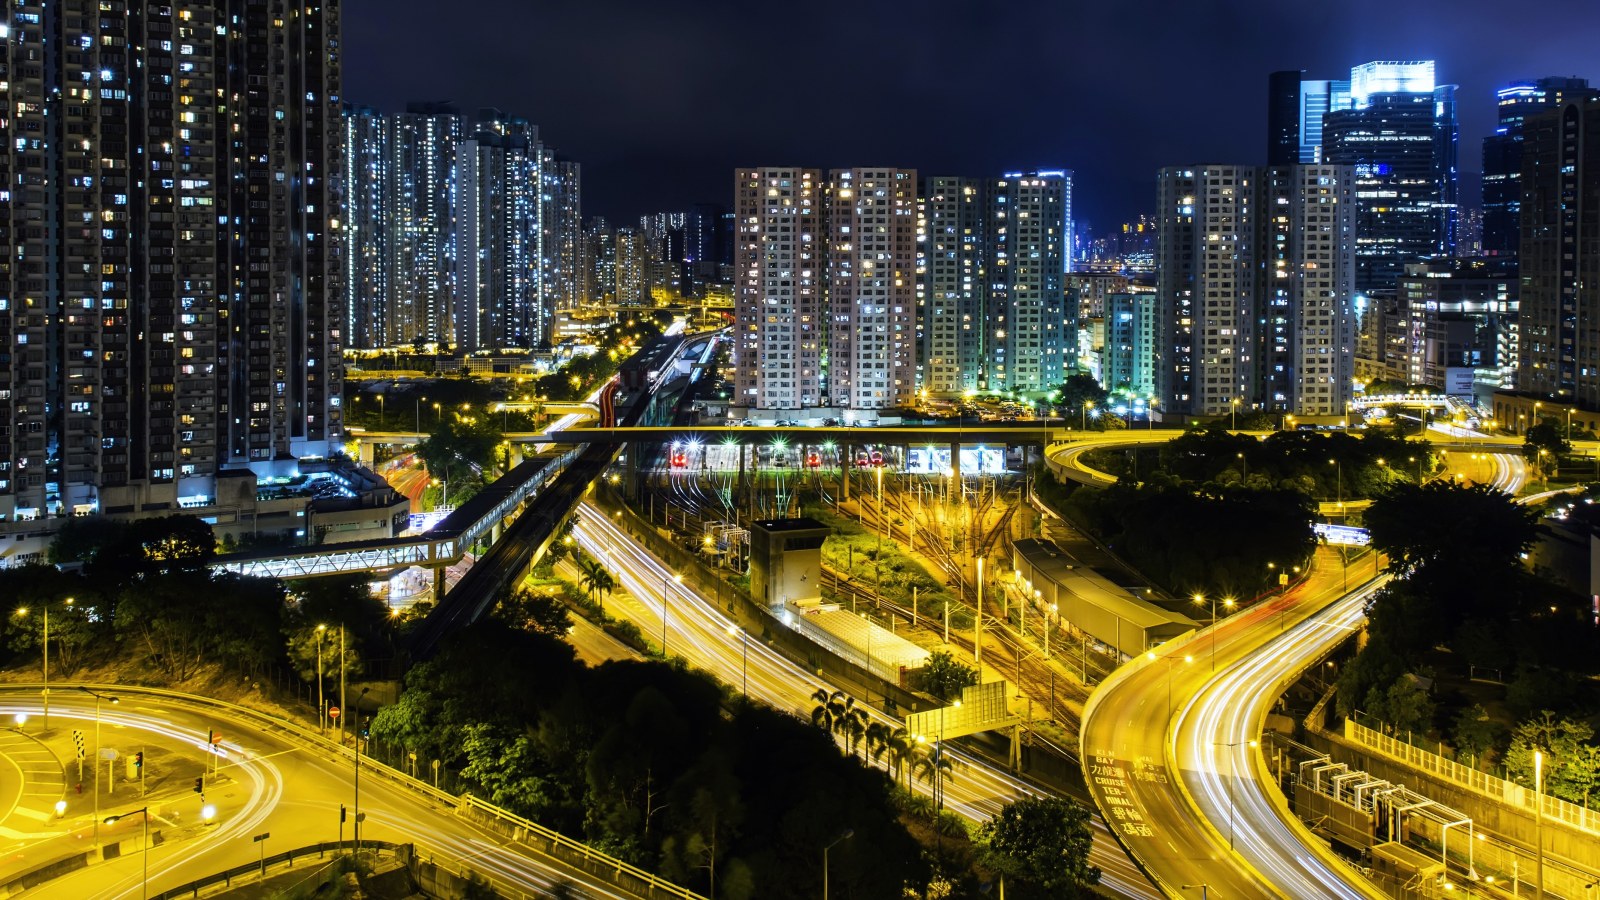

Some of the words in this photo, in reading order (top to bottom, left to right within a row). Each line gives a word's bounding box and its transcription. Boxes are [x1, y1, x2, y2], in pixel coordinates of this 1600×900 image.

[1095, 777, 1126, 787] CRUISE
[1102, 787, 1126, 795] TER-
[1105, 796, 1133, 806] MINAL
[1112, 807, 1142, 820] 郵輪
[1120, 822, 1153, 836] 碼頭
